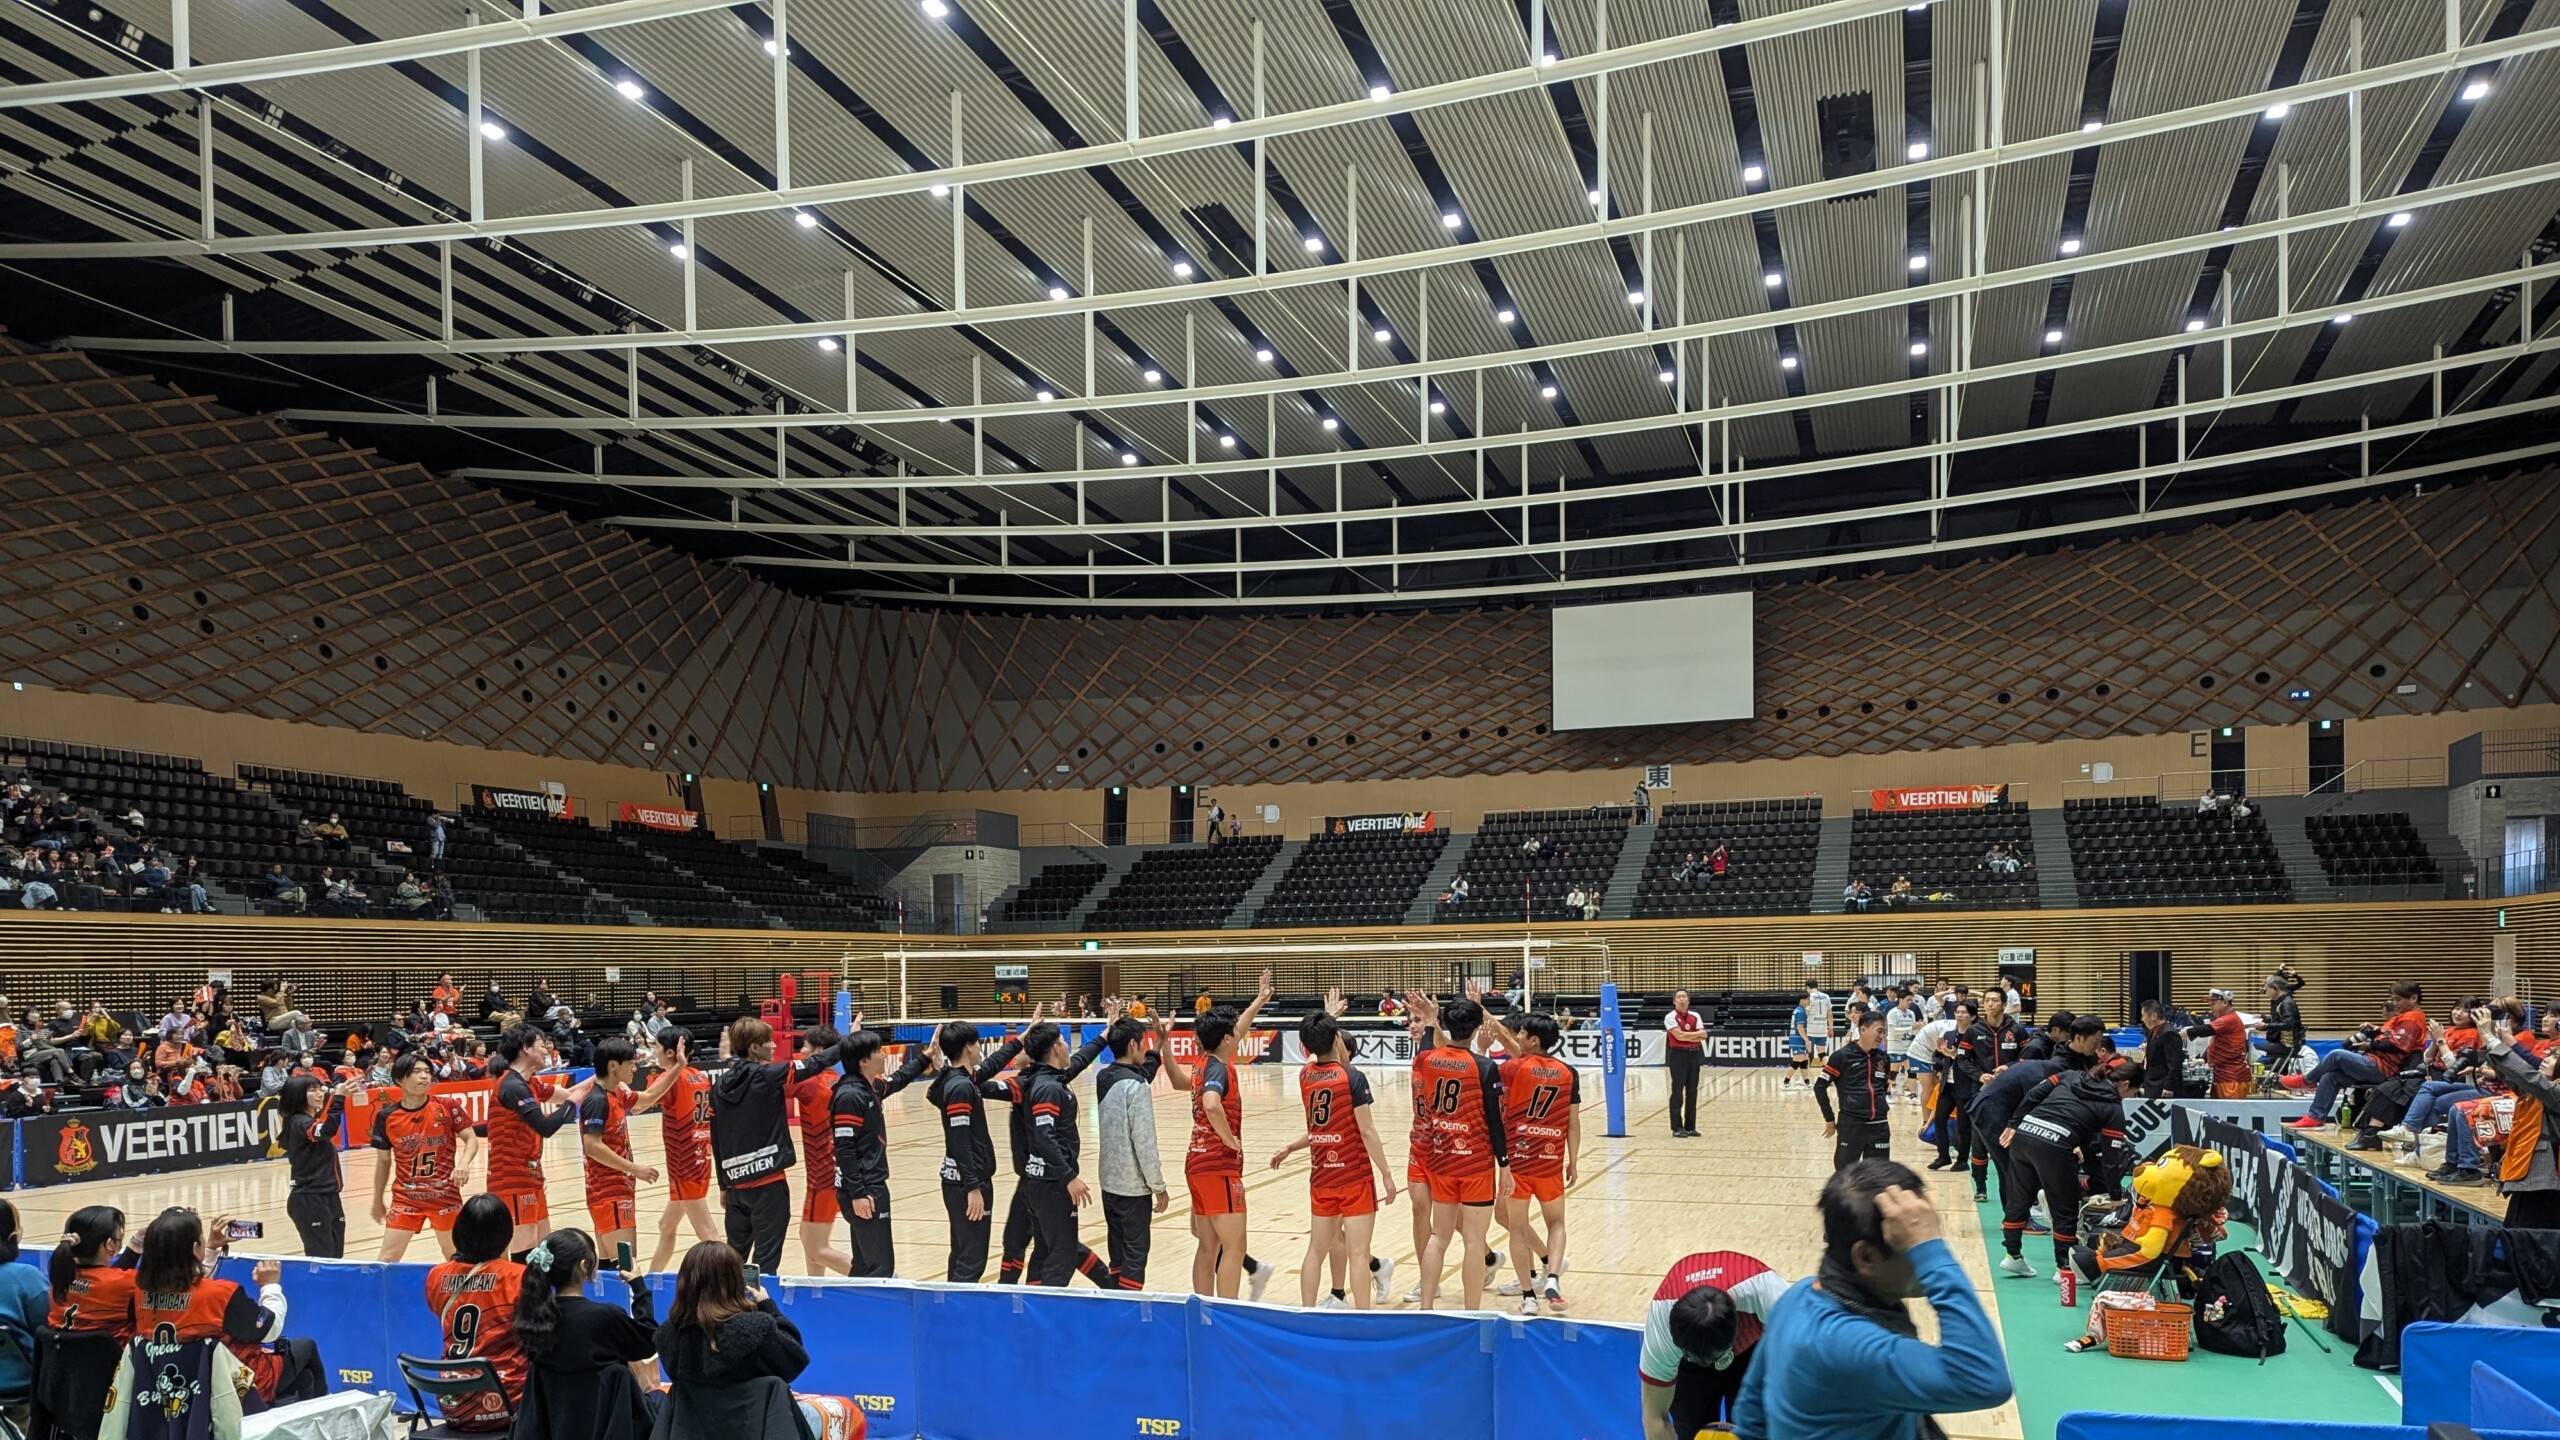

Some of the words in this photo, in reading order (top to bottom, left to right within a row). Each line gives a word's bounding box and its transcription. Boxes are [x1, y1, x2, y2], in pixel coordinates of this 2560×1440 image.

[2191, 732, 2207, 757] E
[666, 773, 682, 797] N
[1648, 765, 1669, 787] 東
[494, 792, 546, 811] VEERTIEN
[547, 798, 567, 814] MIE
[1197, 788, 1210, 807] E
[1900, 791, 1967, 806] VEERTIEN
[1972, 790, 1998, 803] MIE
[638, 809, 680, 827] VEERTIEN
[681, 813, 698, 828] MIE
[1347, 817, 1401, 832] VEERTIEN
[1404, 817, 1426, 829] MIE
[1237, 1037, 1270, 1056] MIE
[1701, 1036, 1791, 1058] VEERTIE
[1606, 1042, 1614, 1074] Senoh
[1532, 1067, 1561, 1079] NARUMI
[1431, 1077, 1462, 1114] 18
[1526, 1084, 1560, 1119] 17
[1308, 1088, 1333, 1126] 13
[100, 1110, 260, 1163] VEERTIEN
[2476, 1121, 2495, 1138] 12
[411, 1150, 437, 1178] 15
[448, 1303, 481, 1359] 9
[339, 1369, 373, 1384] TSP
[854, 1395, 895, 1411] TSP
[1137, 1417, 1181, 1436] TSP
